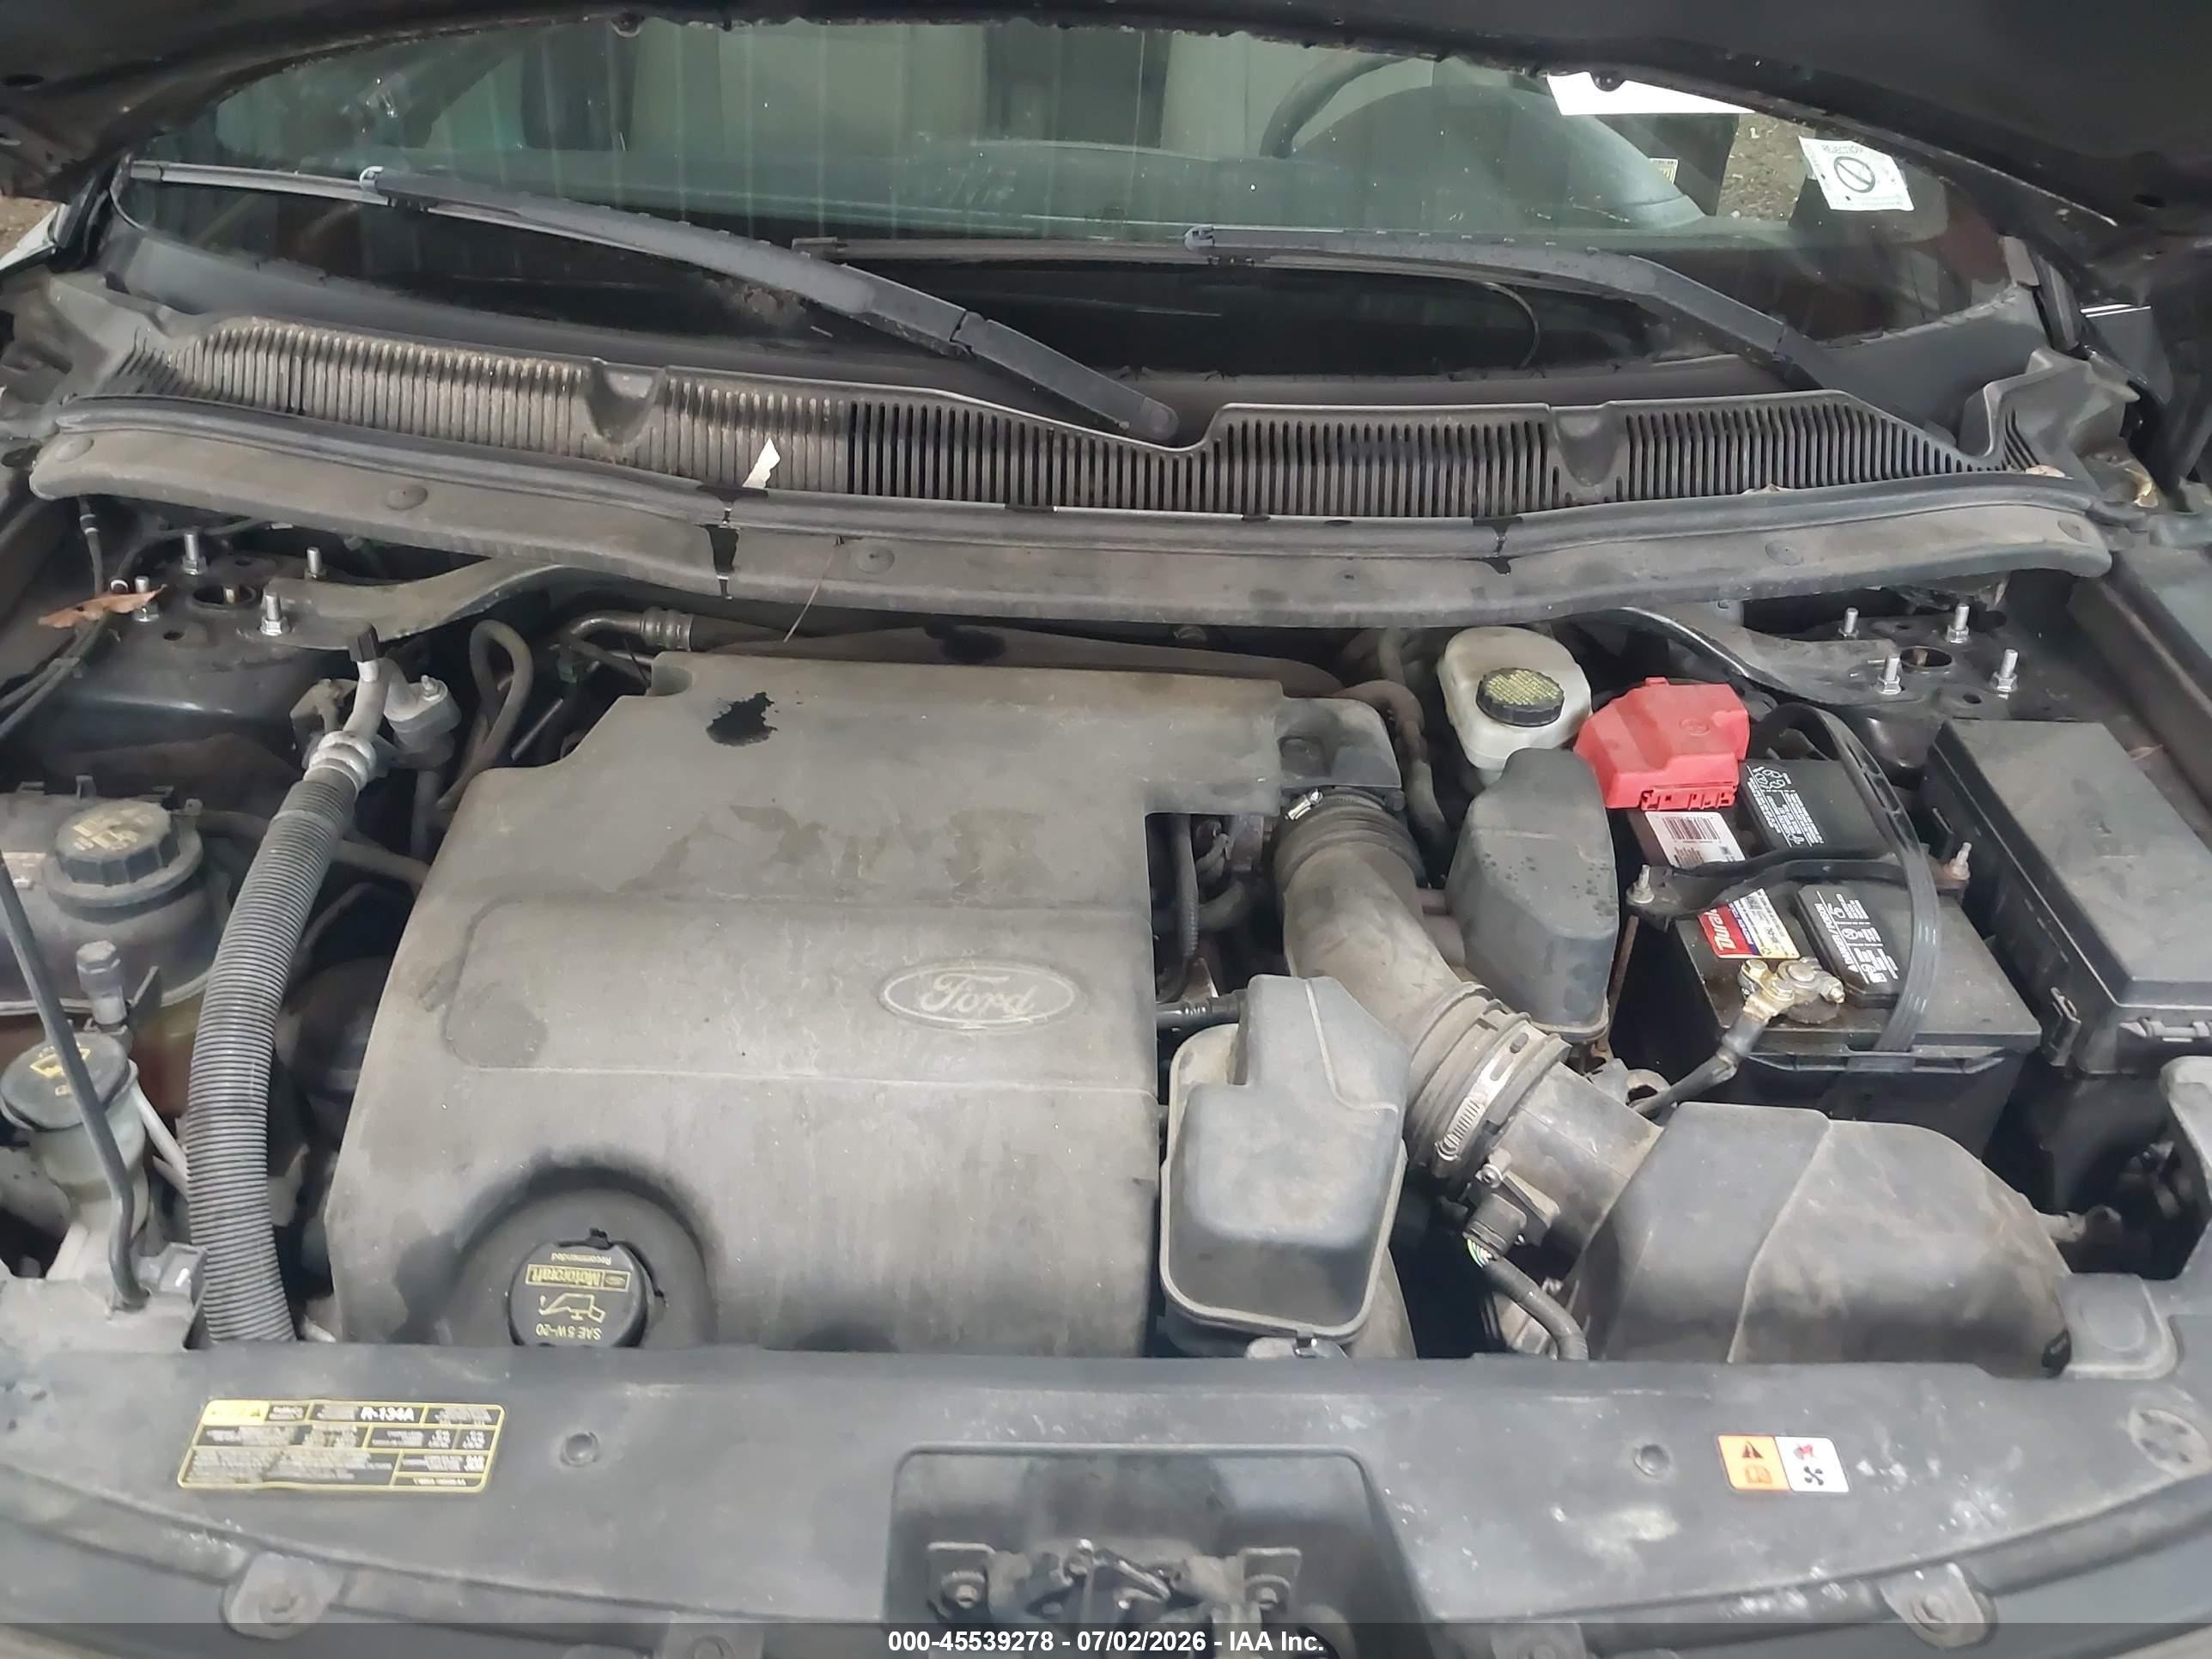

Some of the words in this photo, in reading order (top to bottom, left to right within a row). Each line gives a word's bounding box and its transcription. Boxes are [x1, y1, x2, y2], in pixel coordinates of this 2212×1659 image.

[1814, 902, 1836, 930] POISON
[1832, 934, 1855, 965] DANGER
[920, 972, 1038, 1018] Ford
[550, 1252, 612, 1266] Recommended
[532, 1267, 601, 1286] Motorcraft
[536, 1323, 576, 1339] 5W-20
[577, 1327, 603, 1340] SAE
[360, 1406, 415, 1422] R-134A
